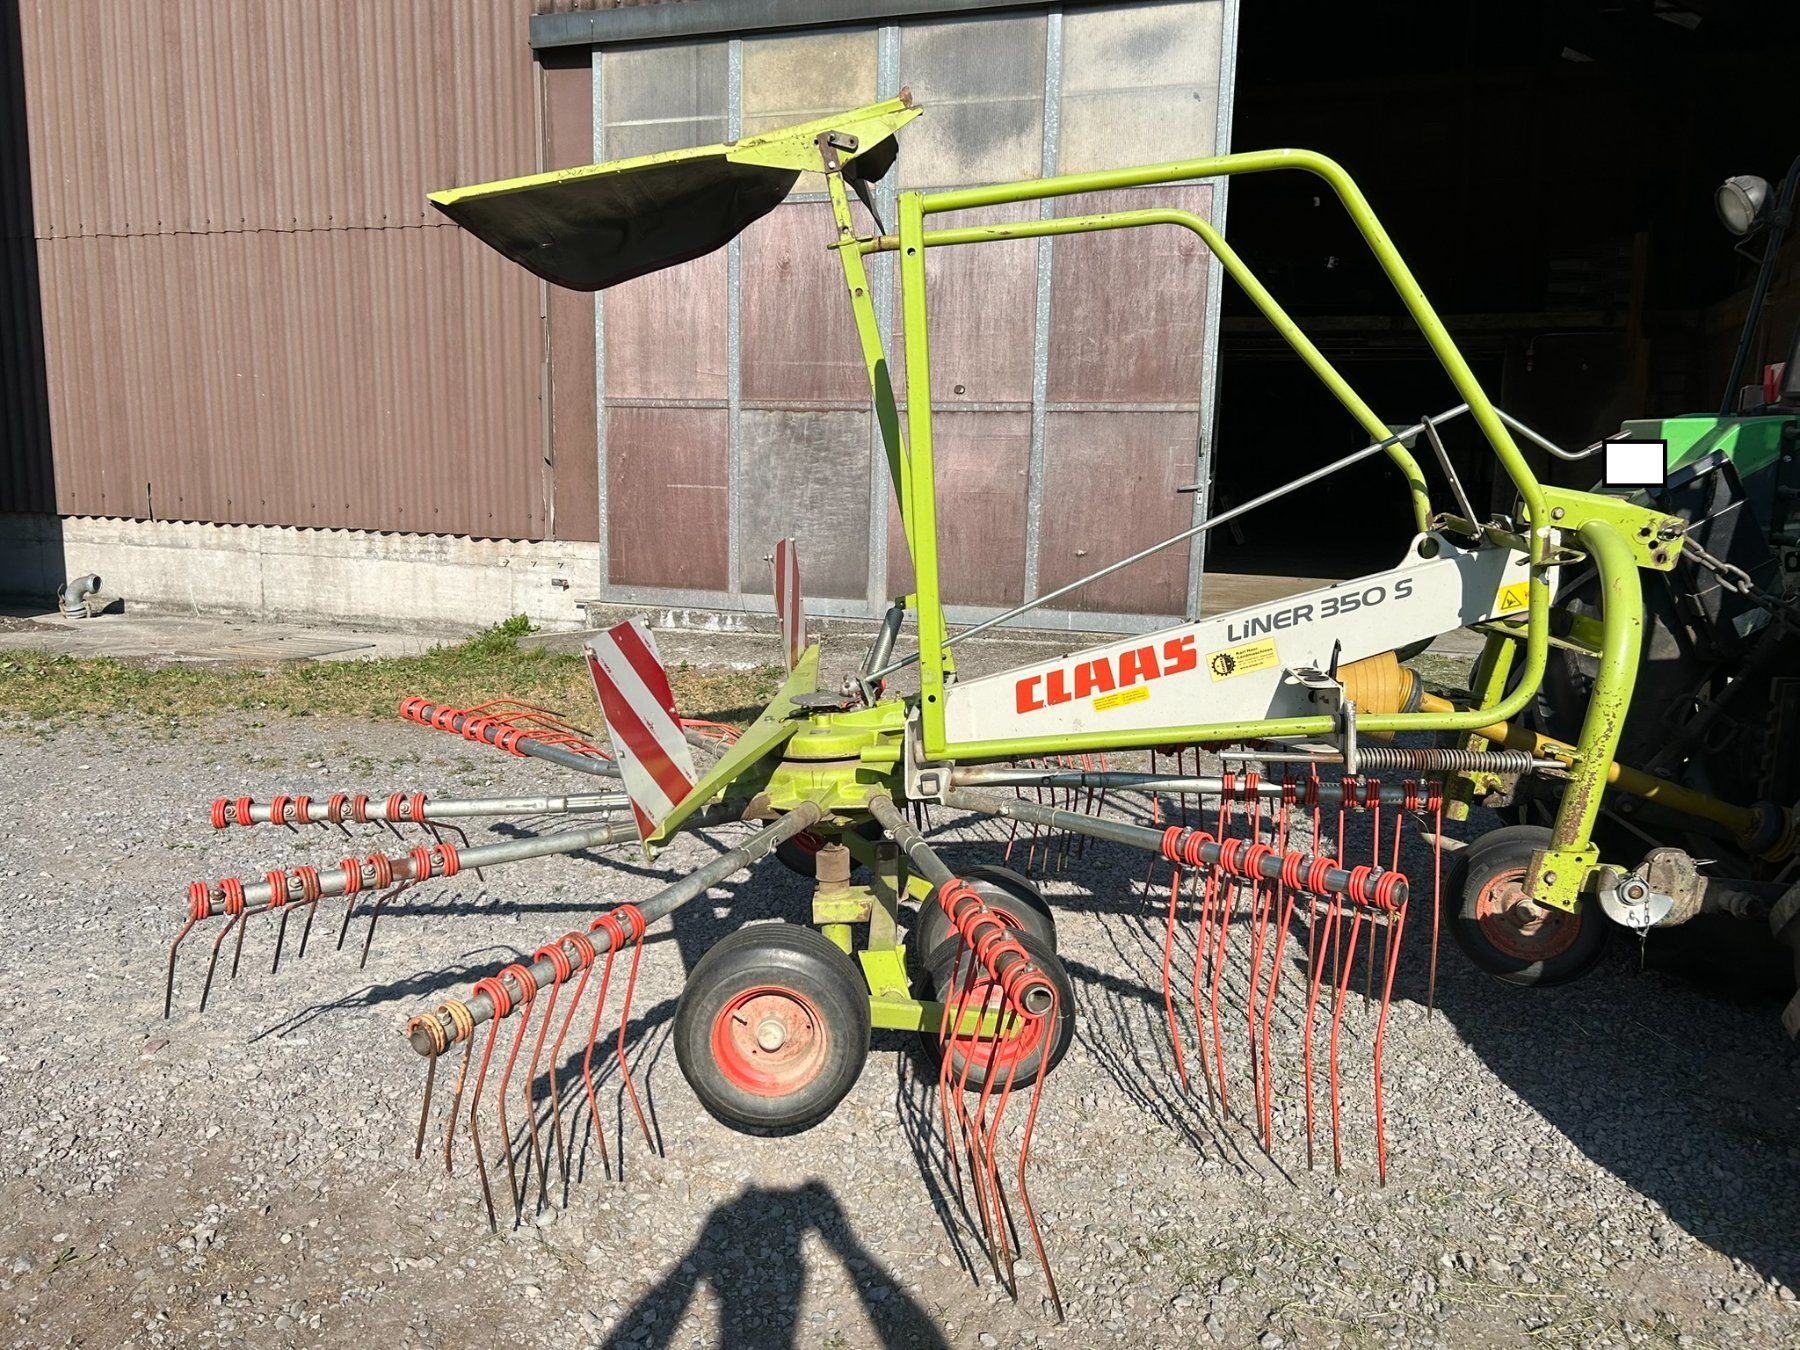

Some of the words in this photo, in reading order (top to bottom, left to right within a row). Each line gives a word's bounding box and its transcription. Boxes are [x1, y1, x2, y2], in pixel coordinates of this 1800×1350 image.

[1321, 586, 1386, 619] 350
[1394, 578, 1413, 600] S
[1016, 635, 1197, 714] CLAAS
